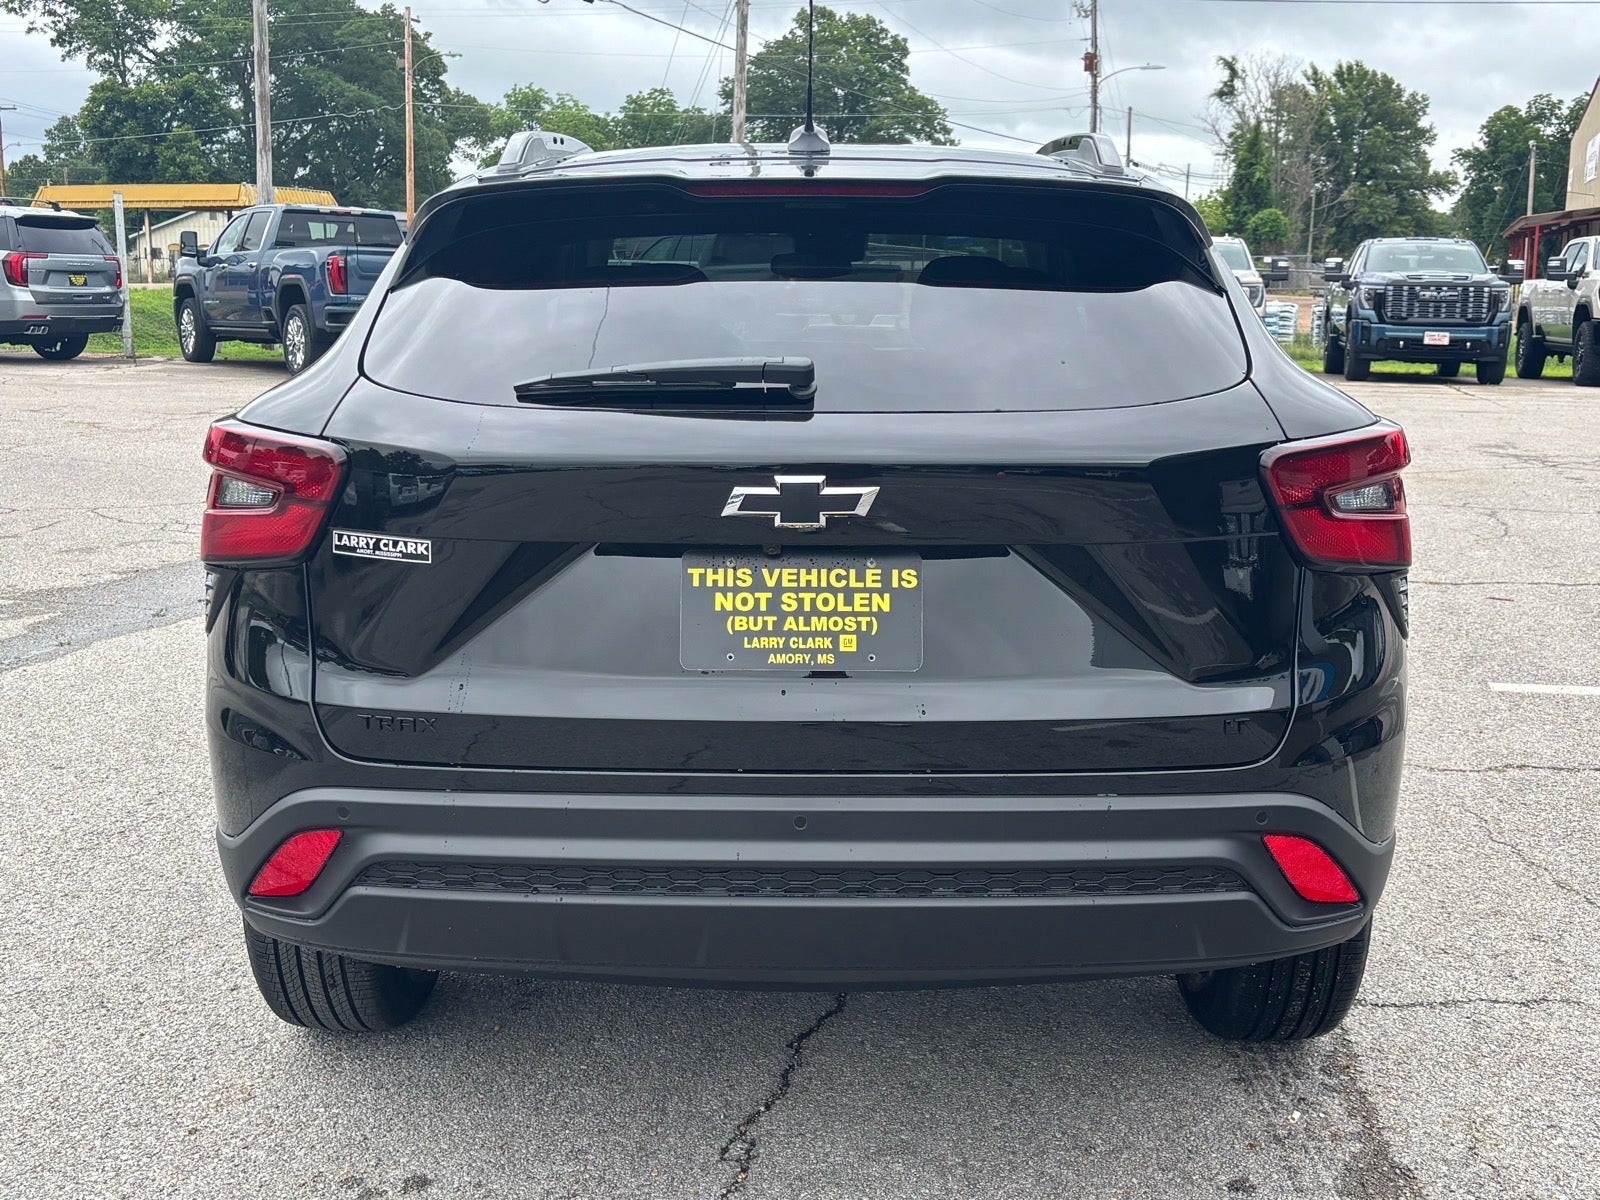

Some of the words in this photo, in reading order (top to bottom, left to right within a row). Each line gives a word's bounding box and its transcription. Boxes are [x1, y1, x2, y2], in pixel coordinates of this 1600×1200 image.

[334, 533, 377, 550] LARRY
[379, 539, 429, 555] CLARK
[687, 568, 753, 588] THIS
[761, 568, 882, 588] VEHICLE
[891, 569, 918, 588] IS
[714, 592, 773, 612] NOT
[780, 592, 890, 612] STOLEN
[726, 616, 777, 635] (BUT
[782, 616, 878, 635] ALMOST)
[743, 637, 785, 649] LARRY
[789, 637, 833, 649] CLARK
[767, 653, 814, 666] AMORY,
[817, 653, 835, 665] MS
